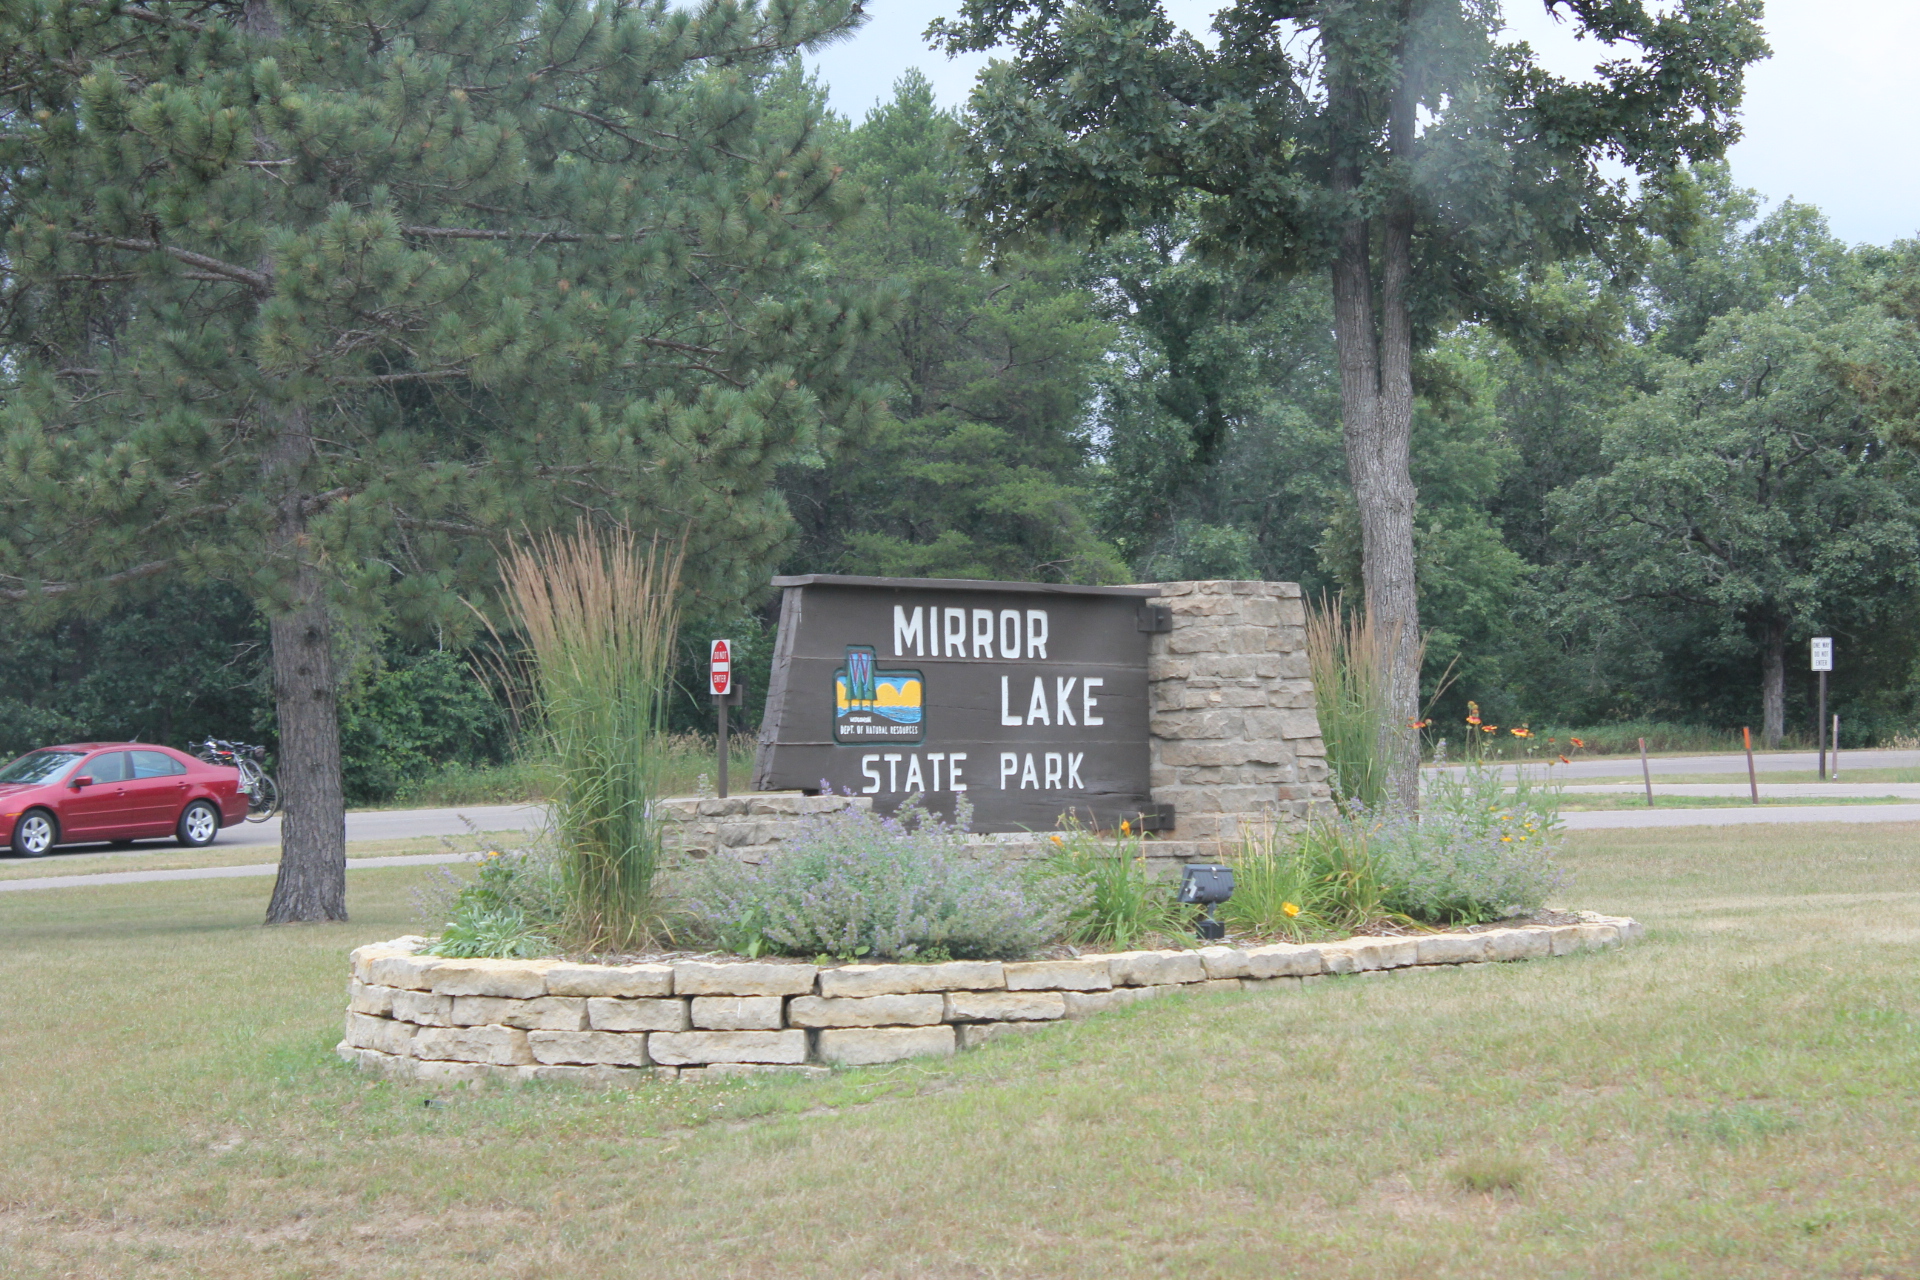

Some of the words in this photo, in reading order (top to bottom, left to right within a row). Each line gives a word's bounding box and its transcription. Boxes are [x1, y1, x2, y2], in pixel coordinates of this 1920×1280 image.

[893, 605, 1048, 659] MIRROR
[713, 674, 726, 683] ENTER
[1001, 675, 1104, 726] LAKE
[840, 725, 855, 735] DEPT.
[856, 725, 864, 735] OF
[865, 725, 888, 735] NATURAL
[890, 725, 918, 735] RESOURCES
[861, 752, 968, 794] STATE
[1000, 751, 1085, 790] PARK
